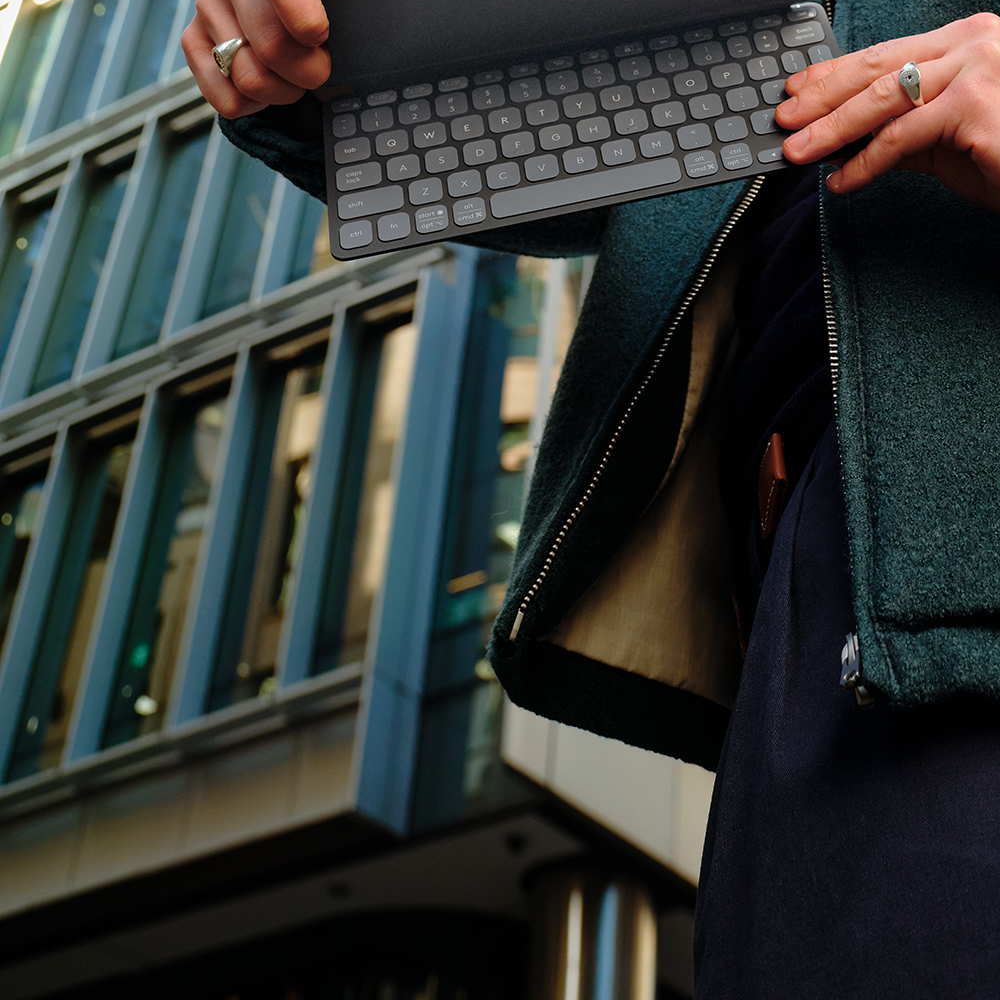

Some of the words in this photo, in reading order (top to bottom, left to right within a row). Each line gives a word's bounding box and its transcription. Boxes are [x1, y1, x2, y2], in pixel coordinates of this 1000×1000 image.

[690, 165, 707, 173] cmd
[346, 170, 362, 178] caps
[418, 211, 435, 219] start
[458, 213, 475, 221] cmd
